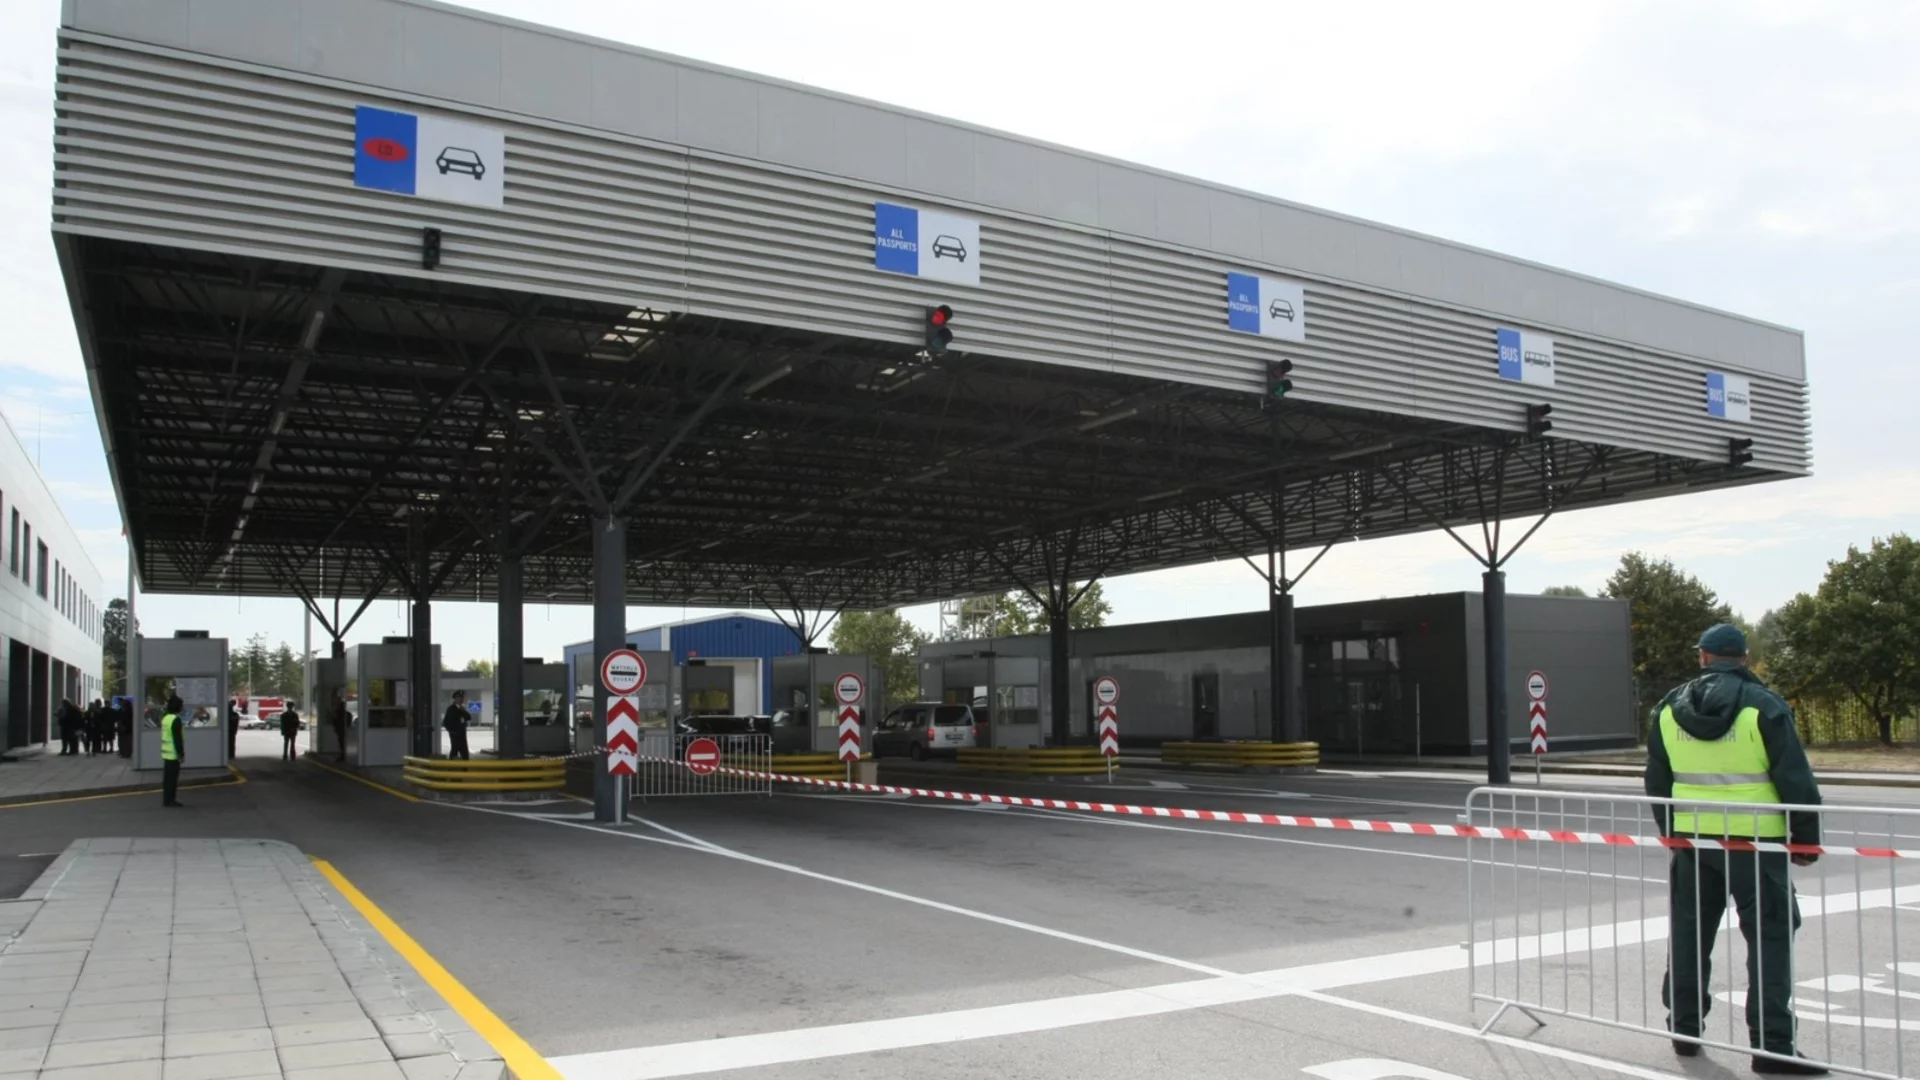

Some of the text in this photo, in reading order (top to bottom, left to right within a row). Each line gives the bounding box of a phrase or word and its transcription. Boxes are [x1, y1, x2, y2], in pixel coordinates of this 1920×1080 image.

[891, 228, 904, 239] ALL
[878, 237, 916, 252] PASSPORTS
[1239, 294, 1249, 303] ALL
[1229, 301, 1259, 314] PASSPORTS
[1501, 346, 1518, 362] BUS
[1709, 387, 1723, 402] BUS
